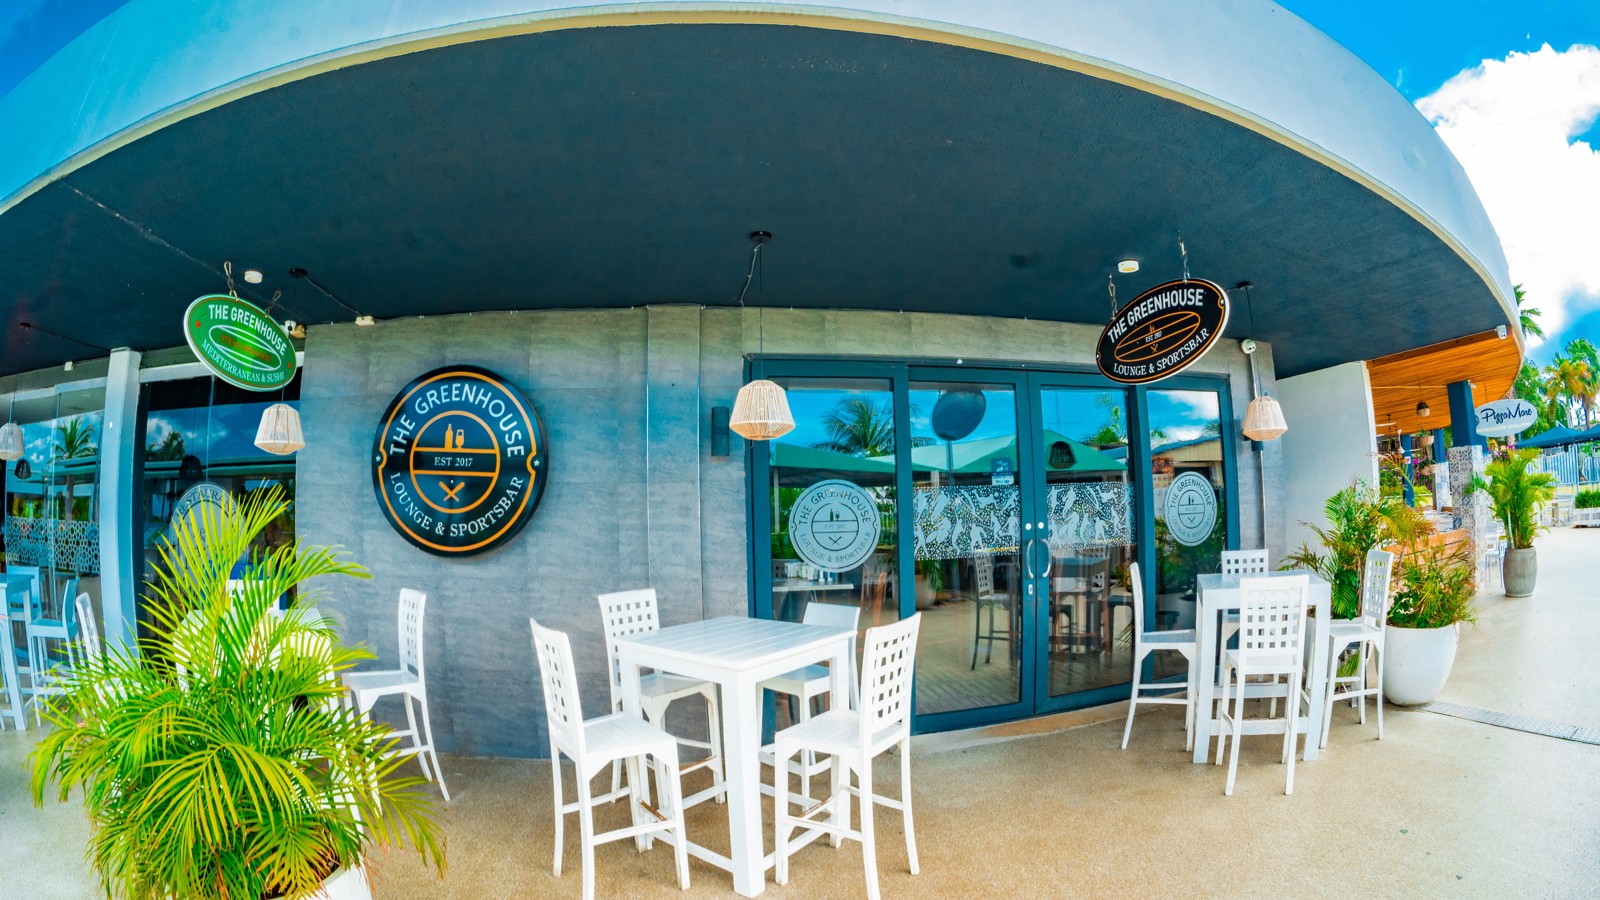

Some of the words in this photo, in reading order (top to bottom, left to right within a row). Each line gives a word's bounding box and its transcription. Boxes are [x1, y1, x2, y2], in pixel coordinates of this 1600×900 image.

[208, 304, 229, 320] THE
[230, 306, 287, 356] GREENHOUSE
[1107, 317, 1128, 343] THE
[1127, 288, 1204, 327] GREENHOUSE
[201, 339, 260, 382] MEDITERRANEAN
[260, 373, 266, 382] &
[266, 371, 285, 382] SUSHI
[1113, 363, 1147, 376] LOUNGE
[1148, 363, 1155, 373] &
[1156, 327, 1210, 371] SPORTSBAR
[389, 414, 416, 455] THE
[414, 383, 525, 458] GREENHOUSE
[434, 456, 452, 466] EST
[454, 456, 474, 467] 2017
[177, 489, 237, 517] ESTAURN
[390, 472, 433, 530] LOUNGE
[435, 521, 445, 536] &
[450, 475, 524, 537] SPORTSBAR
[798, 504, 813, 525] THE
[810, 489, 871, 523] GREENHOUSE
[1170, 491, 1179, 508] THE
[1176, 479, 1212, 506] GREENHOUSE
[800, 533, 826, 560] LOUNGE
[835, 531, 872, 563] SPORTSBAR
